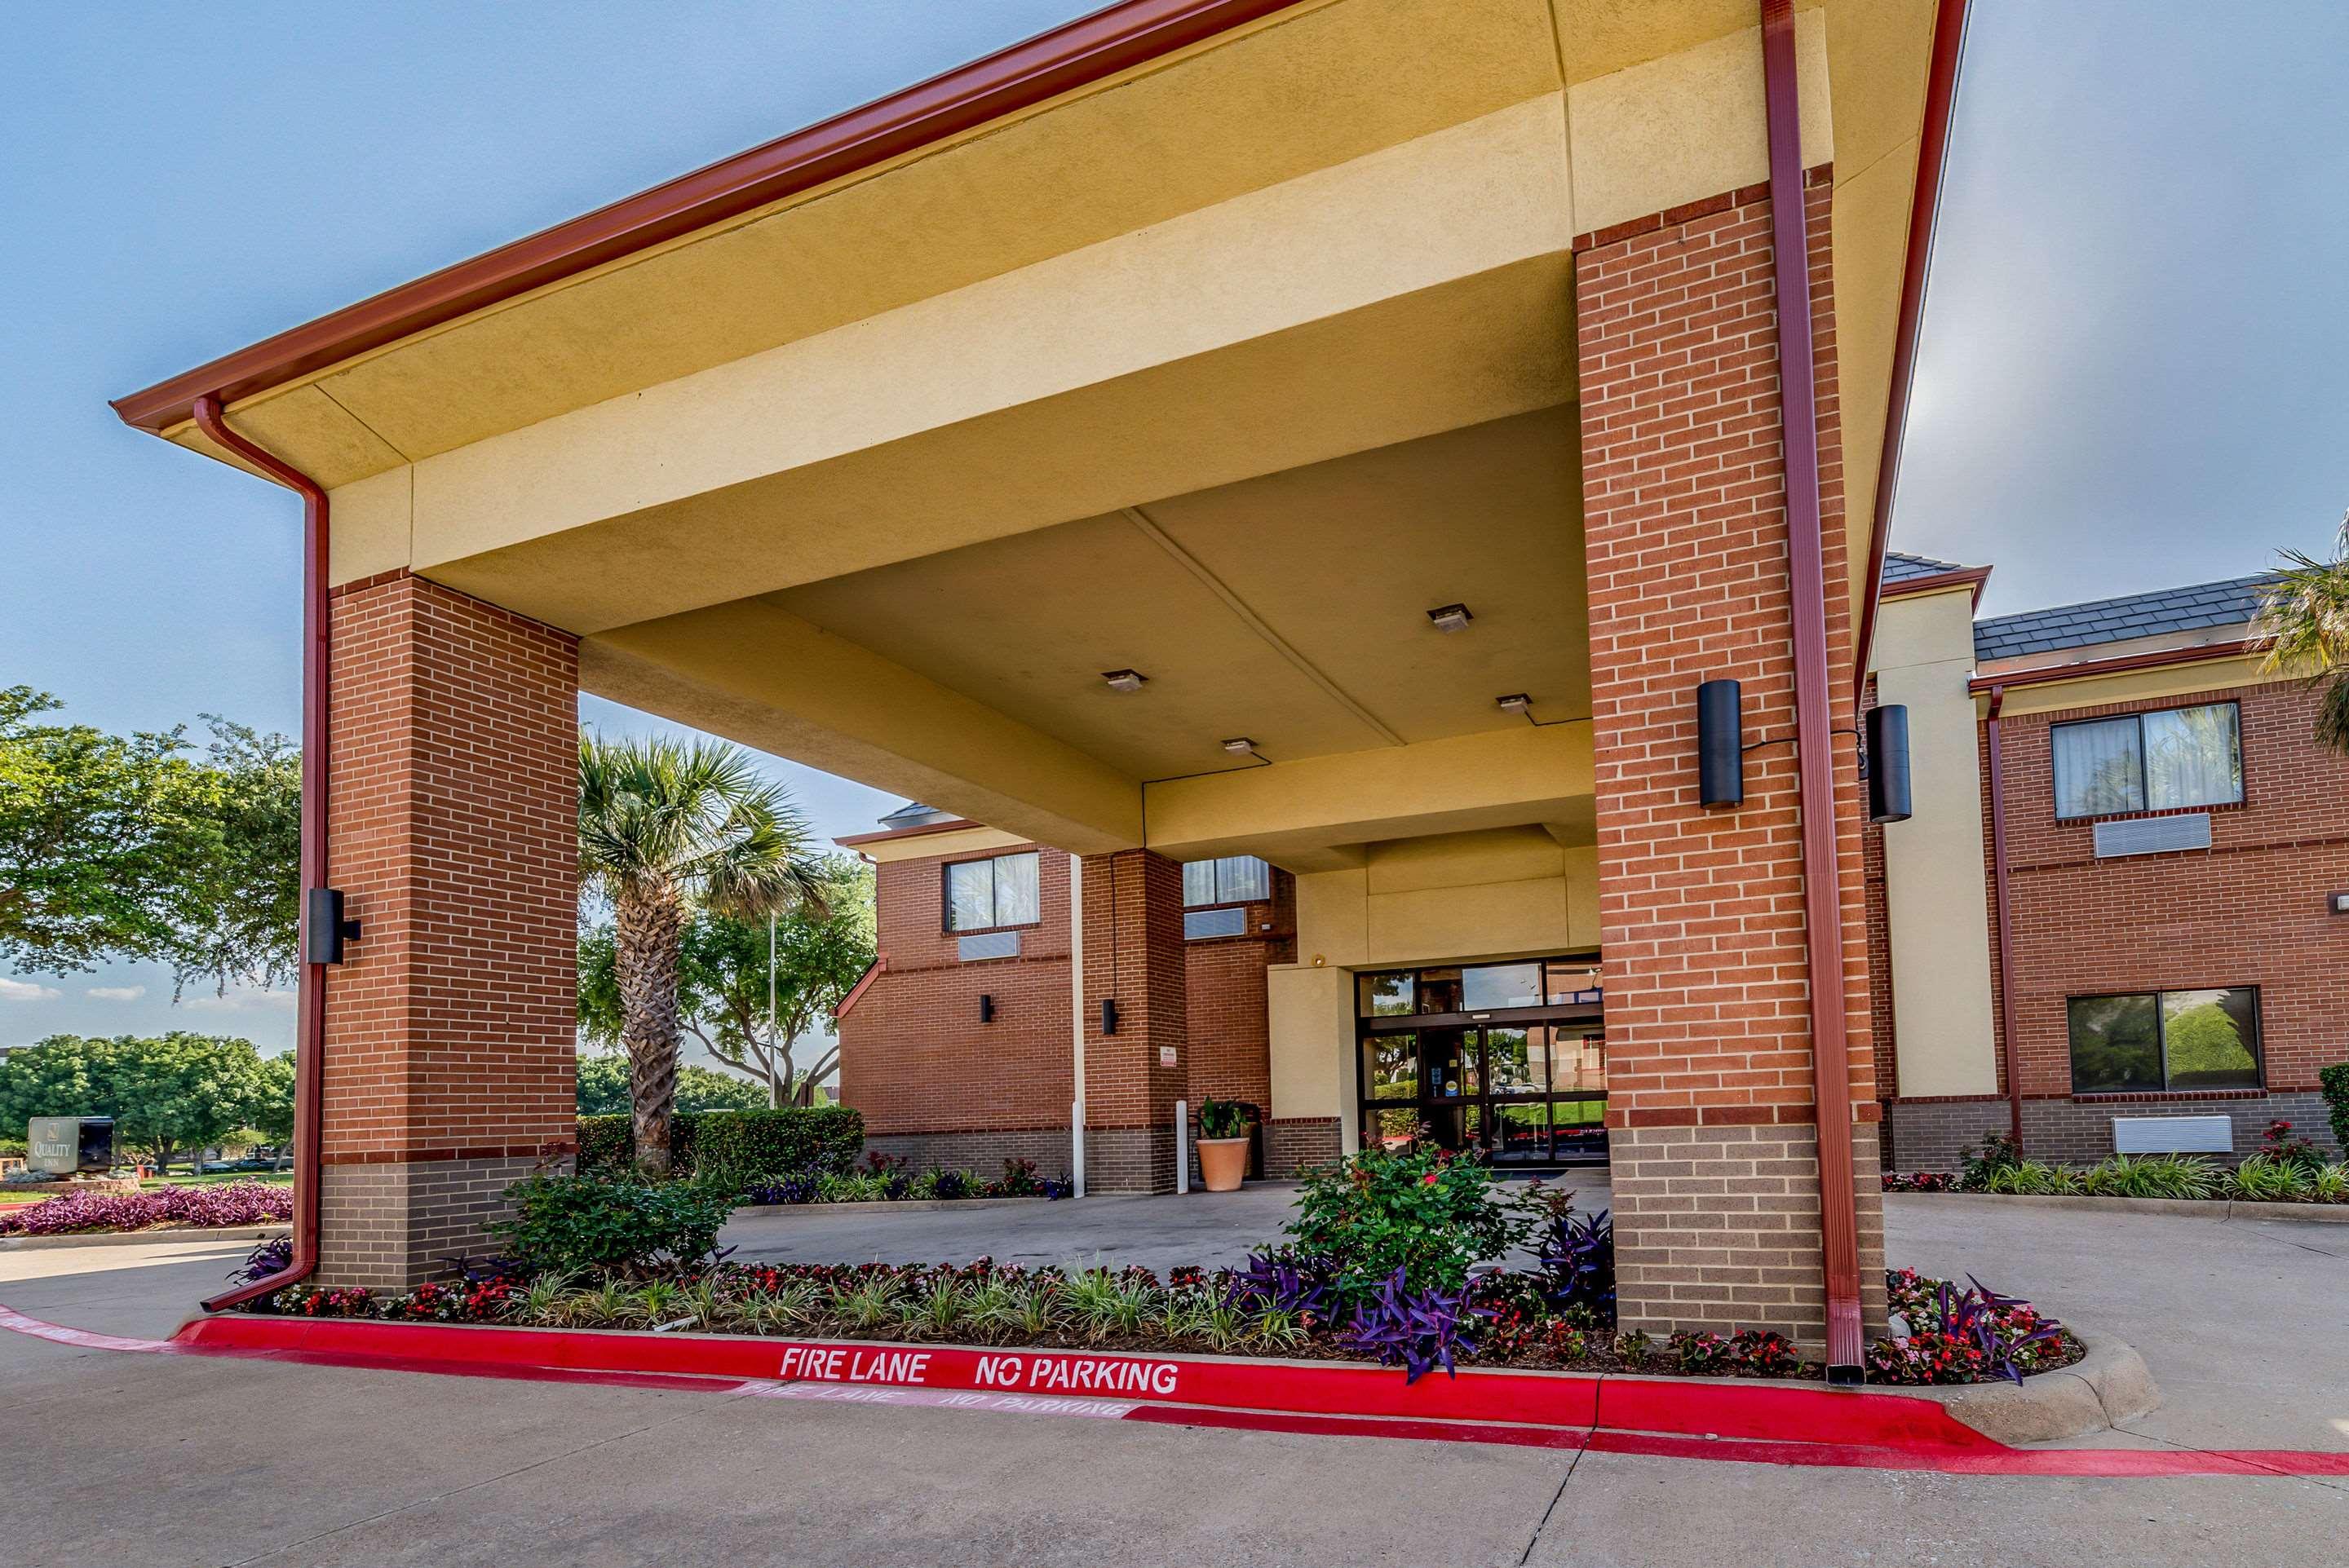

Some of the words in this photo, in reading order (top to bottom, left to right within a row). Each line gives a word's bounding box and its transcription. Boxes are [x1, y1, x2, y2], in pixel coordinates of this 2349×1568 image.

[34, 1142, 70, 1157] QUALITY
[44, 1159, 60, 1167] INN
[780, 1348, 847, 1379] FIRE
[849, 1351, 931, 1383] LANE
[975, 1356, 1022, 1386] NO
[1029, 1358, 1179, 1394] PARKING
[939, 1394, 989, 1406] NO
[991, 1397, 1131, 1416] PARKING
